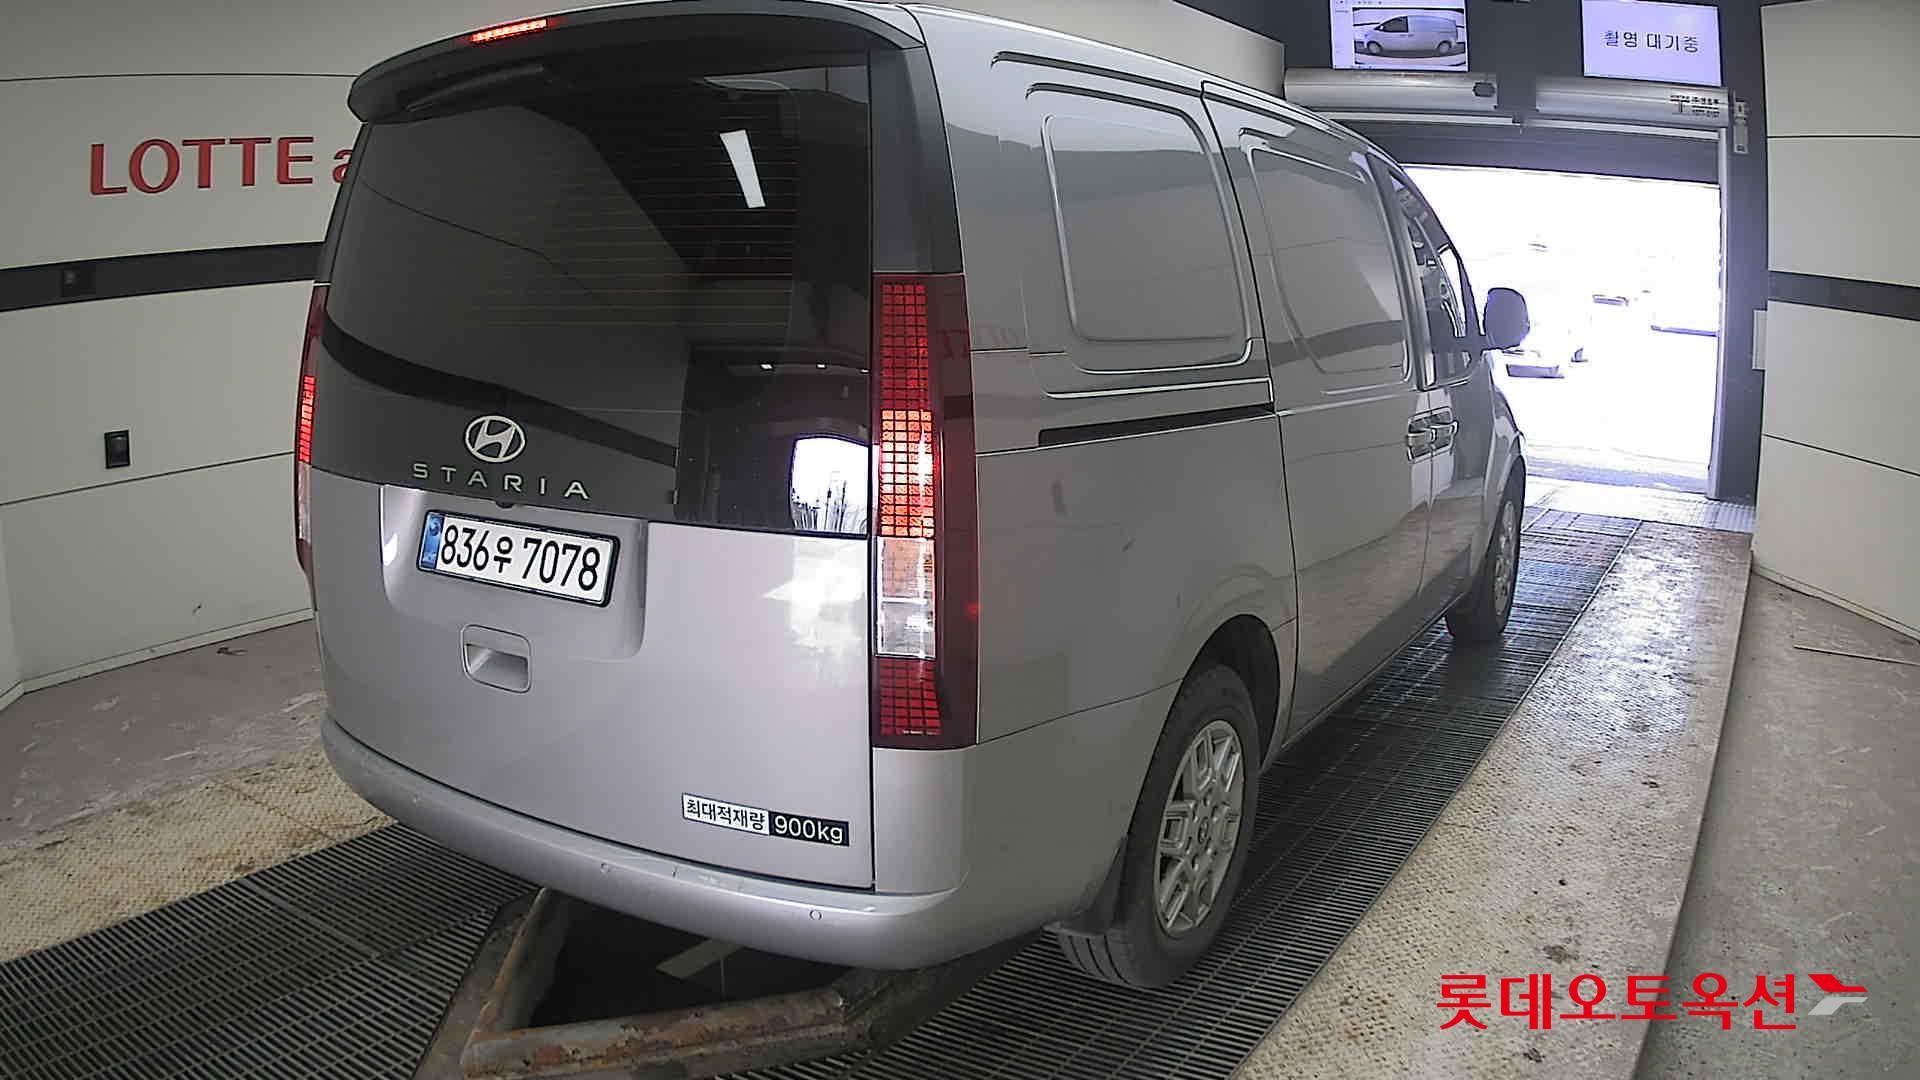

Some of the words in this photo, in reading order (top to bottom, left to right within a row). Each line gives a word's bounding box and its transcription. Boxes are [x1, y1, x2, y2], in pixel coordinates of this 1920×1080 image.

[1646, 33, 1698, 53] 대기중
[90, 137, 314, 195] LOTTE
[412, 462, 590, 500] STARIA
[440, 524, 513, 574] 836우
[521, 538, 601, 591] 7078
[687, 799, 766, 830] 최대적재량
[774, 815, 843, 843] 900kg
